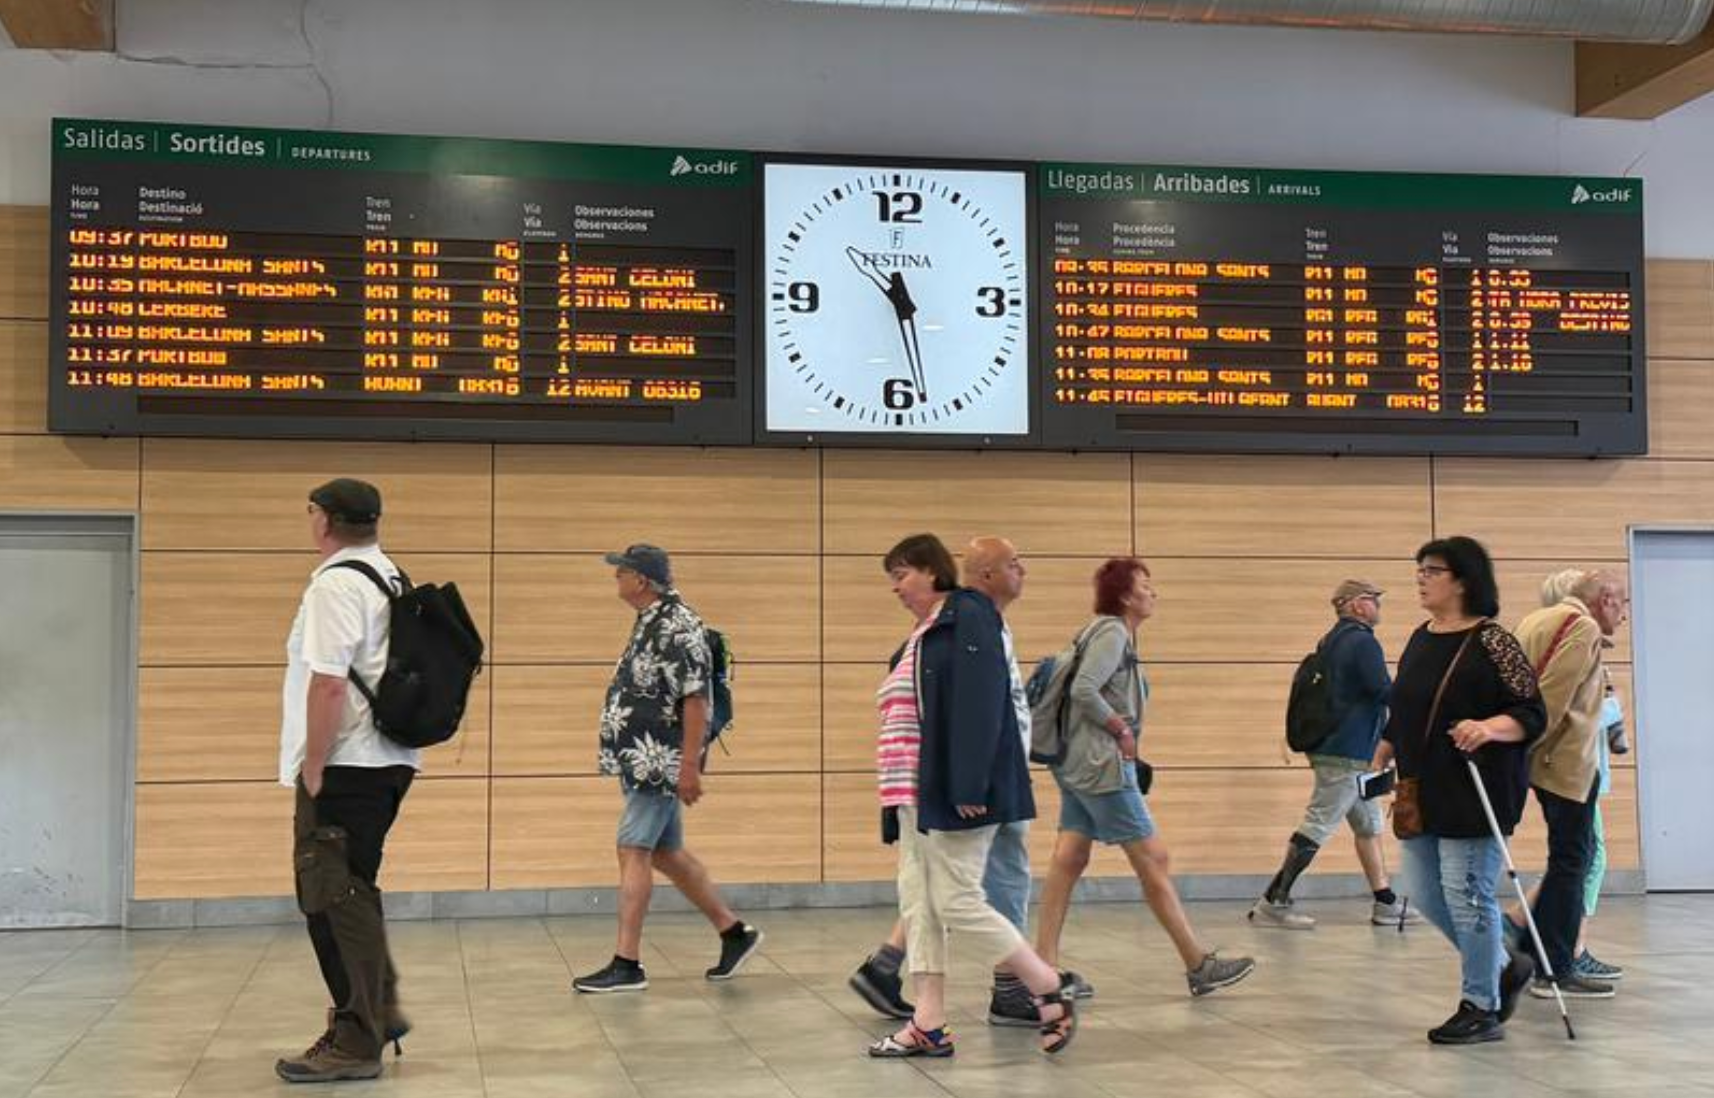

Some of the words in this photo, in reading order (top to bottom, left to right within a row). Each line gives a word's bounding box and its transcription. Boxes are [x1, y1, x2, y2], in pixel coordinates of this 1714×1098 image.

[64, 128, 145, 150] Salidas
[170, 132, 266, 156] Sortides
[291, 147, 371, 162] DEPARTURES
[694, 160, 738, 175] adif
[1048, 170, 1134, 193] Llegadas
[1154, 173, 1250, 194] Arribades
[1268, 184, 1321, 196] ARRIVALS
[71, 184, 99, 196] Hora
[138, 186, 187, 199] Destino
[1593, 188, 1632, 202] adif
[71, 199, 99, 211] Hora
[138, 201, 203, 215] Destinació
[366, 196, 391, 208] Tren
[872, 191, 923, 223] 12
[366, 210, 392, 222] Tren
[575, 205, 655, 218] Observaciones
[574, 218, 647, 231] Observacions
[1055, 222, 1080, 233] Hora
[1113, 222, 1176, 235] Procedencia
[1055, 234, 1080, 245] Hora
[1305, 228, 1327, 239] Tren
[1487, 232, 1558, 244] Observaciones
[1306, 240, 1328, 251] Tren
[1487, 245, 1553, 256] Observacions
[862, 254, 932, 268] FESTINA
[788, 282, 820, 313] 9
[975, 287, 1006, 318] 3
[883, 379, 914, 410] 6
